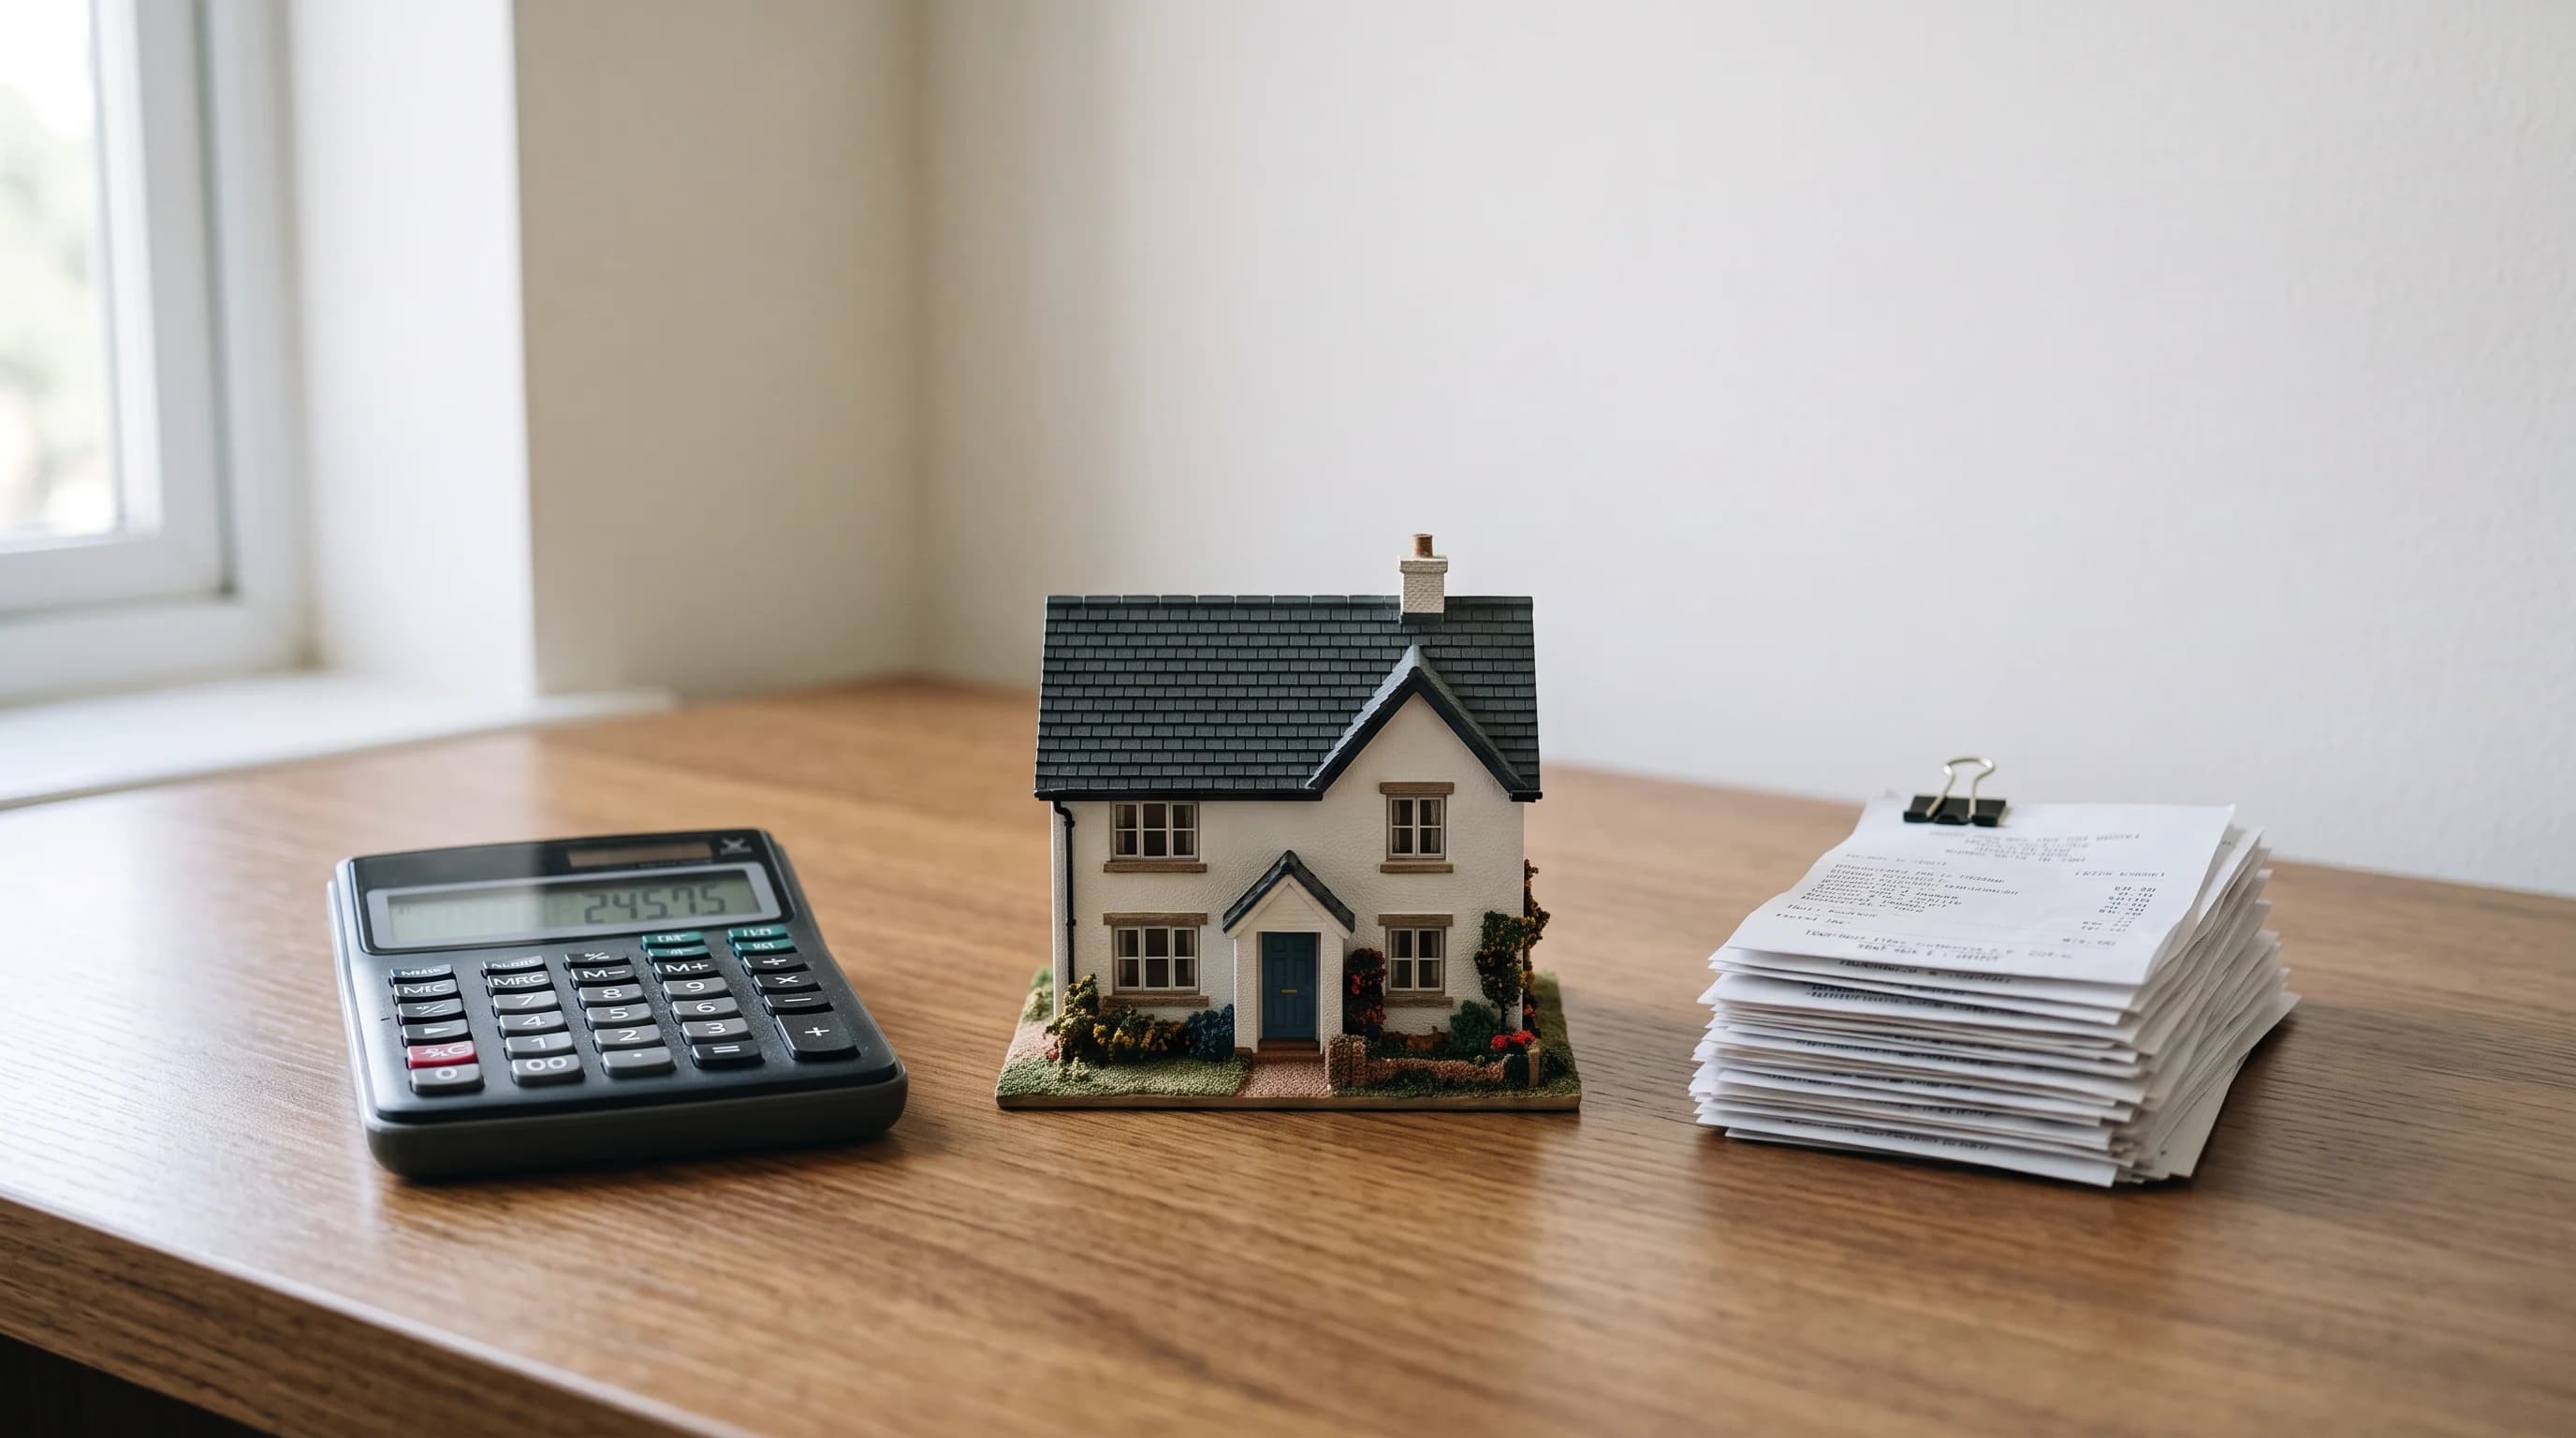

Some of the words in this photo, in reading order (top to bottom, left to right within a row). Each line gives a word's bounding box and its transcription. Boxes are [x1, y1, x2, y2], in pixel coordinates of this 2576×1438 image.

[666, 961, 709, 973] M+
[685, 982, 705, 992] 9
[602, 989, 622, 999] 8
[516, 995, 535, 1005] 7
[610, 1007, 628, 1019] 5
[695, 1002, 717, 1013] 6
[522, 1016, 545, 1026] 4
[707, 1023, 726, 1034] 3
[619, 1030, 640, 1041] 2
[531, 1037, 547, 1049] 1
[526, 1058, 567, 1071] 00
[435, 1067, 457, 1079] 0
